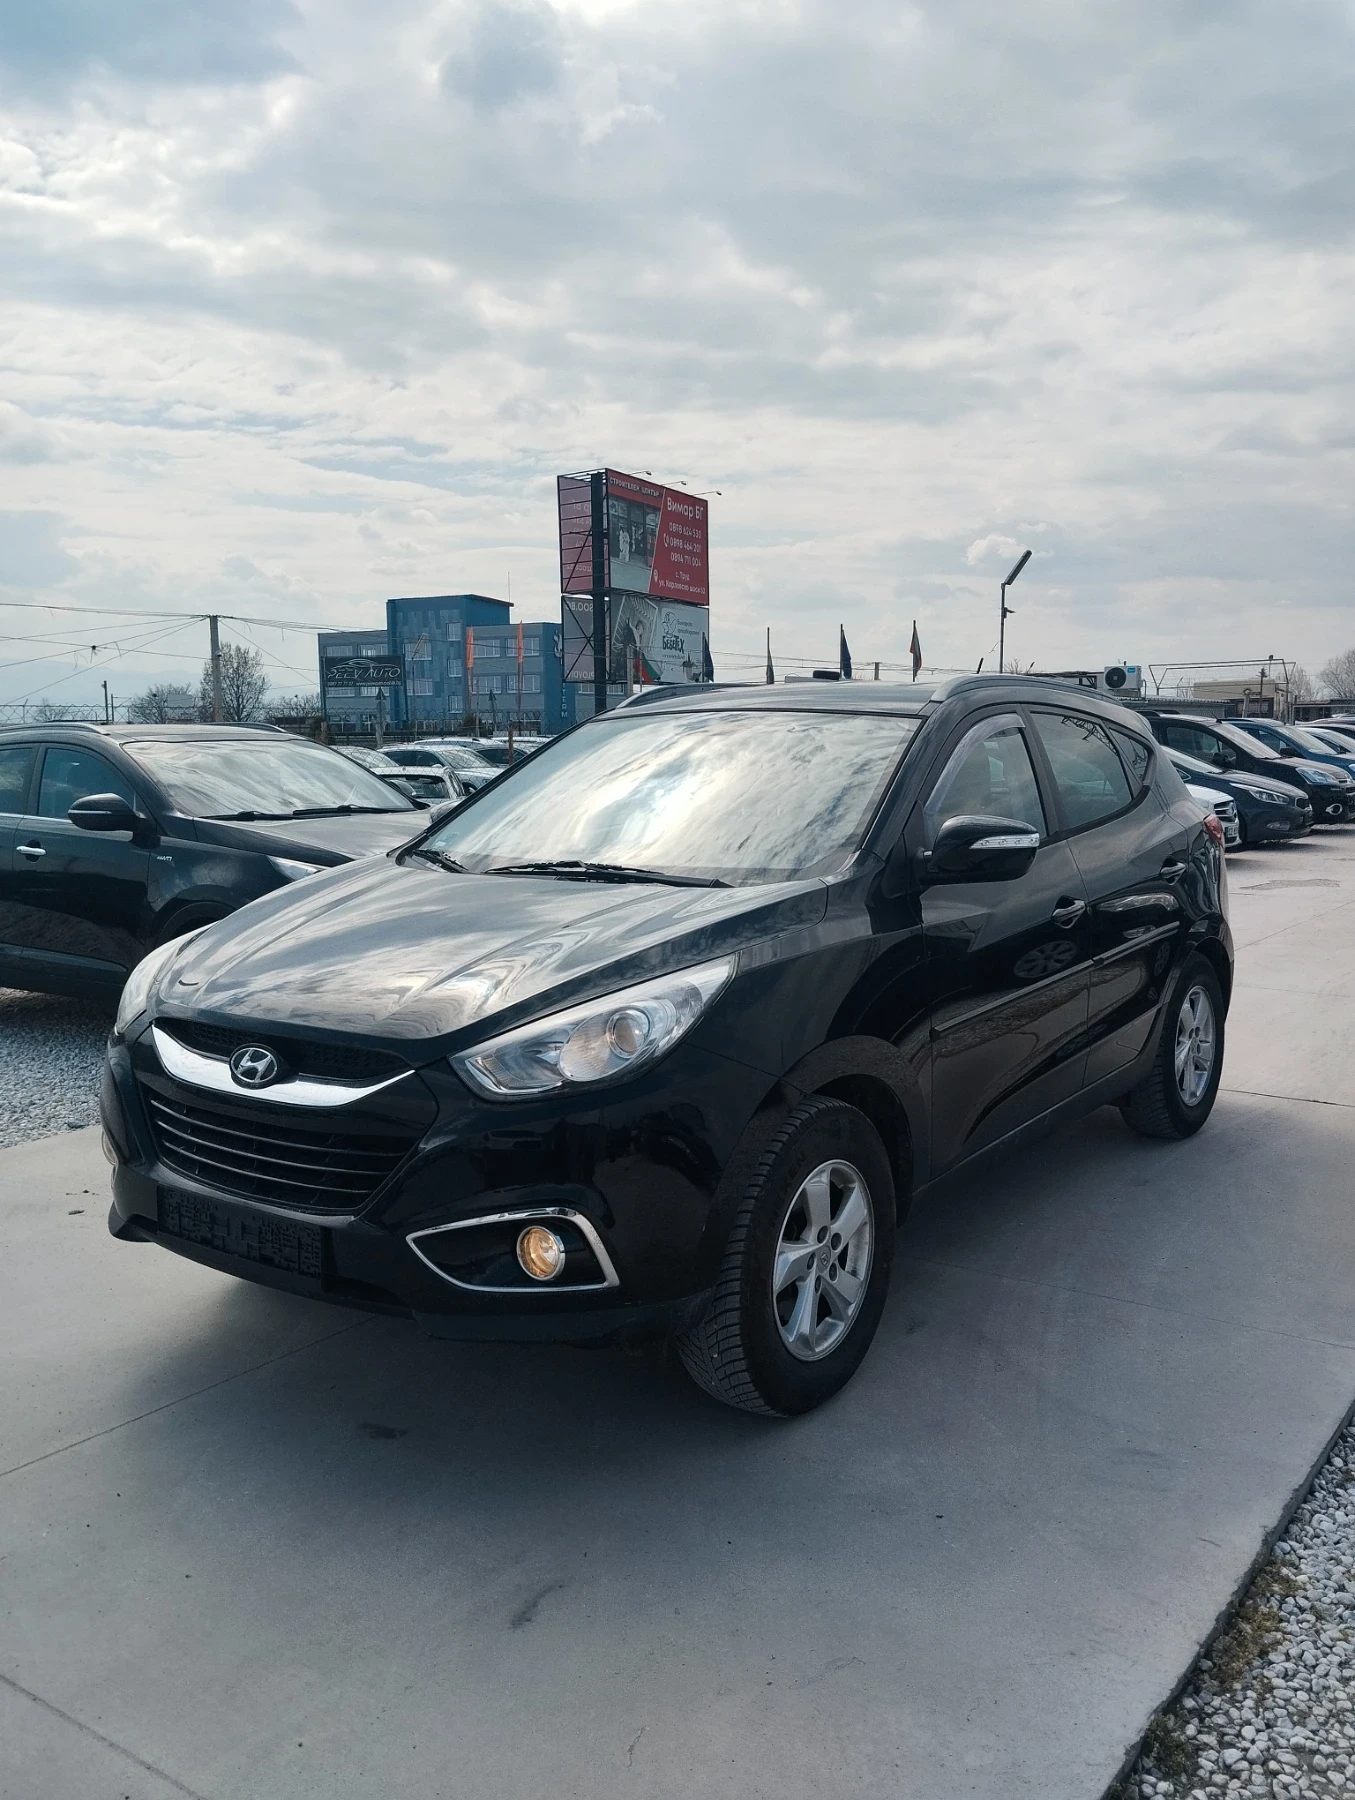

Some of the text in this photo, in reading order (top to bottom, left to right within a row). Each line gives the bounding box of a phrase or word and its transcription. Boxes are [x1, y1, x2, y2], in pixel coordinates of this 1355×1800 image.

[667, 498, 704, 520] Вимар БГ
[326, 666, 401, 679] PEEV AUTO
